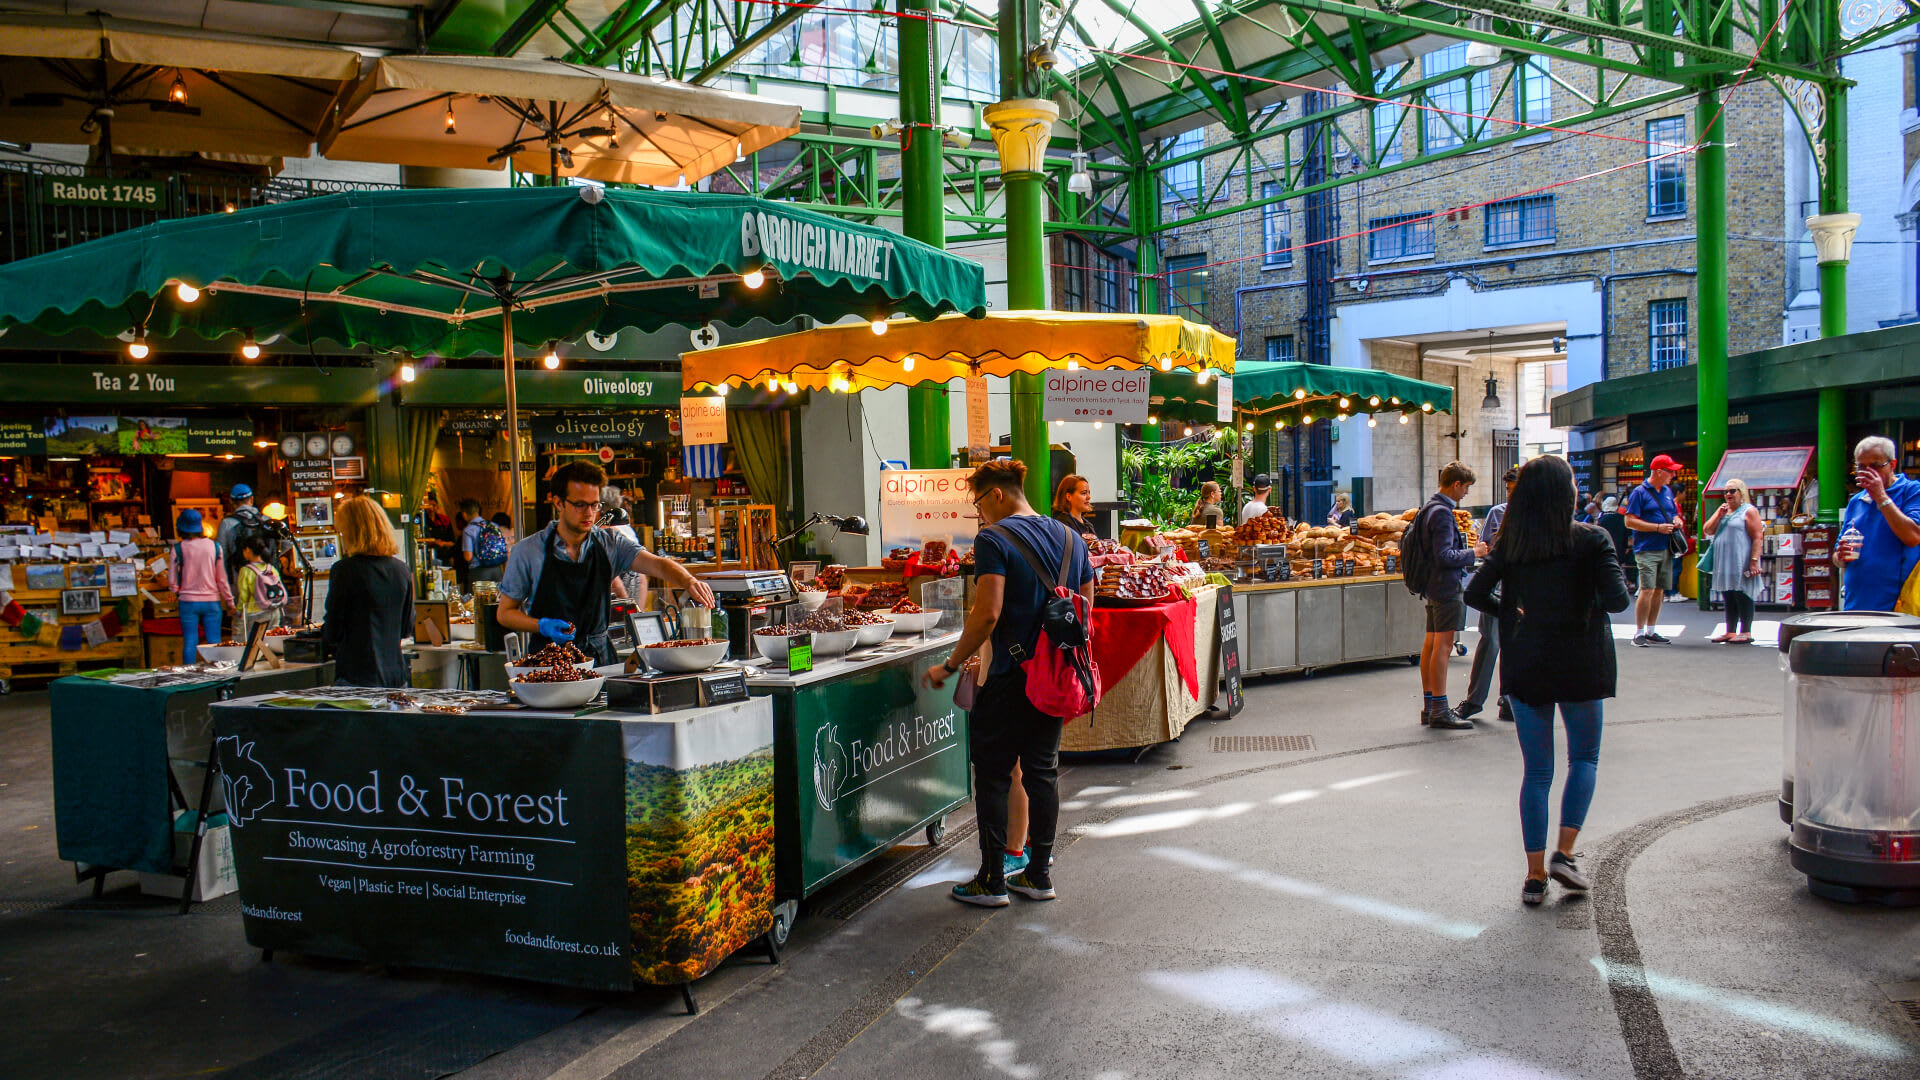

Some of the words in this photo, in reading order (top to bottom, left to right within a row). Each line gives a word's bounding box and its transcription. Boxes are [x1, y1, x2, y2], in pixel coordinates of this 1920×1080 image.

[53, 182, 107, 201] Rabot
[113, 185, 156, 203] 1745
[741, 211, 827, 269] BOROUGH
[828, 229, 894, 281] MARKET
[92, 372, 121, 391] Tea
[129, 373, 140, 391] 2
[146, 373, 175, 392] You
[583, 378, 653, 396] Oliveology
[1048, 375, 1107, 394] alpine
[1112, 376, 1146, 393] deli
[683, 402, 708, 420] alpine
[709, 402, 725, 416] deli
[1728, 411, 1749, 425] ountain
[452, 420, 492, 430] ORGANIC
[500, 420, 529, 428] GEK
[555, 417, 645, 437] oliveology
[886, 474, 949, 496] alpine
[851, 724, 894, 778] Food
[898, 722, 911, 756] &
[915, 708, 956, 750] Forest
[284, 768, 384, 815] Food
[397, 774, 430, 818] &
[439, 777, 569, 827] Forest
[288, 830, 367, 858] Showcasing
[370, 838, 466, 864] Agroforestry
[470, 844, 536, 871] Farming
[319, 875, 351, 893] Vegan
[359, 878, 394, 895] Plastic
[398, 881, 423, 895] Free
[432, 884, 466, 899] Social
[469, 887, 527, 906] Enterprise
[241, 900, 303, 921] oodandforest
[505, 929, 621, 956] foodandforest.co.uk
